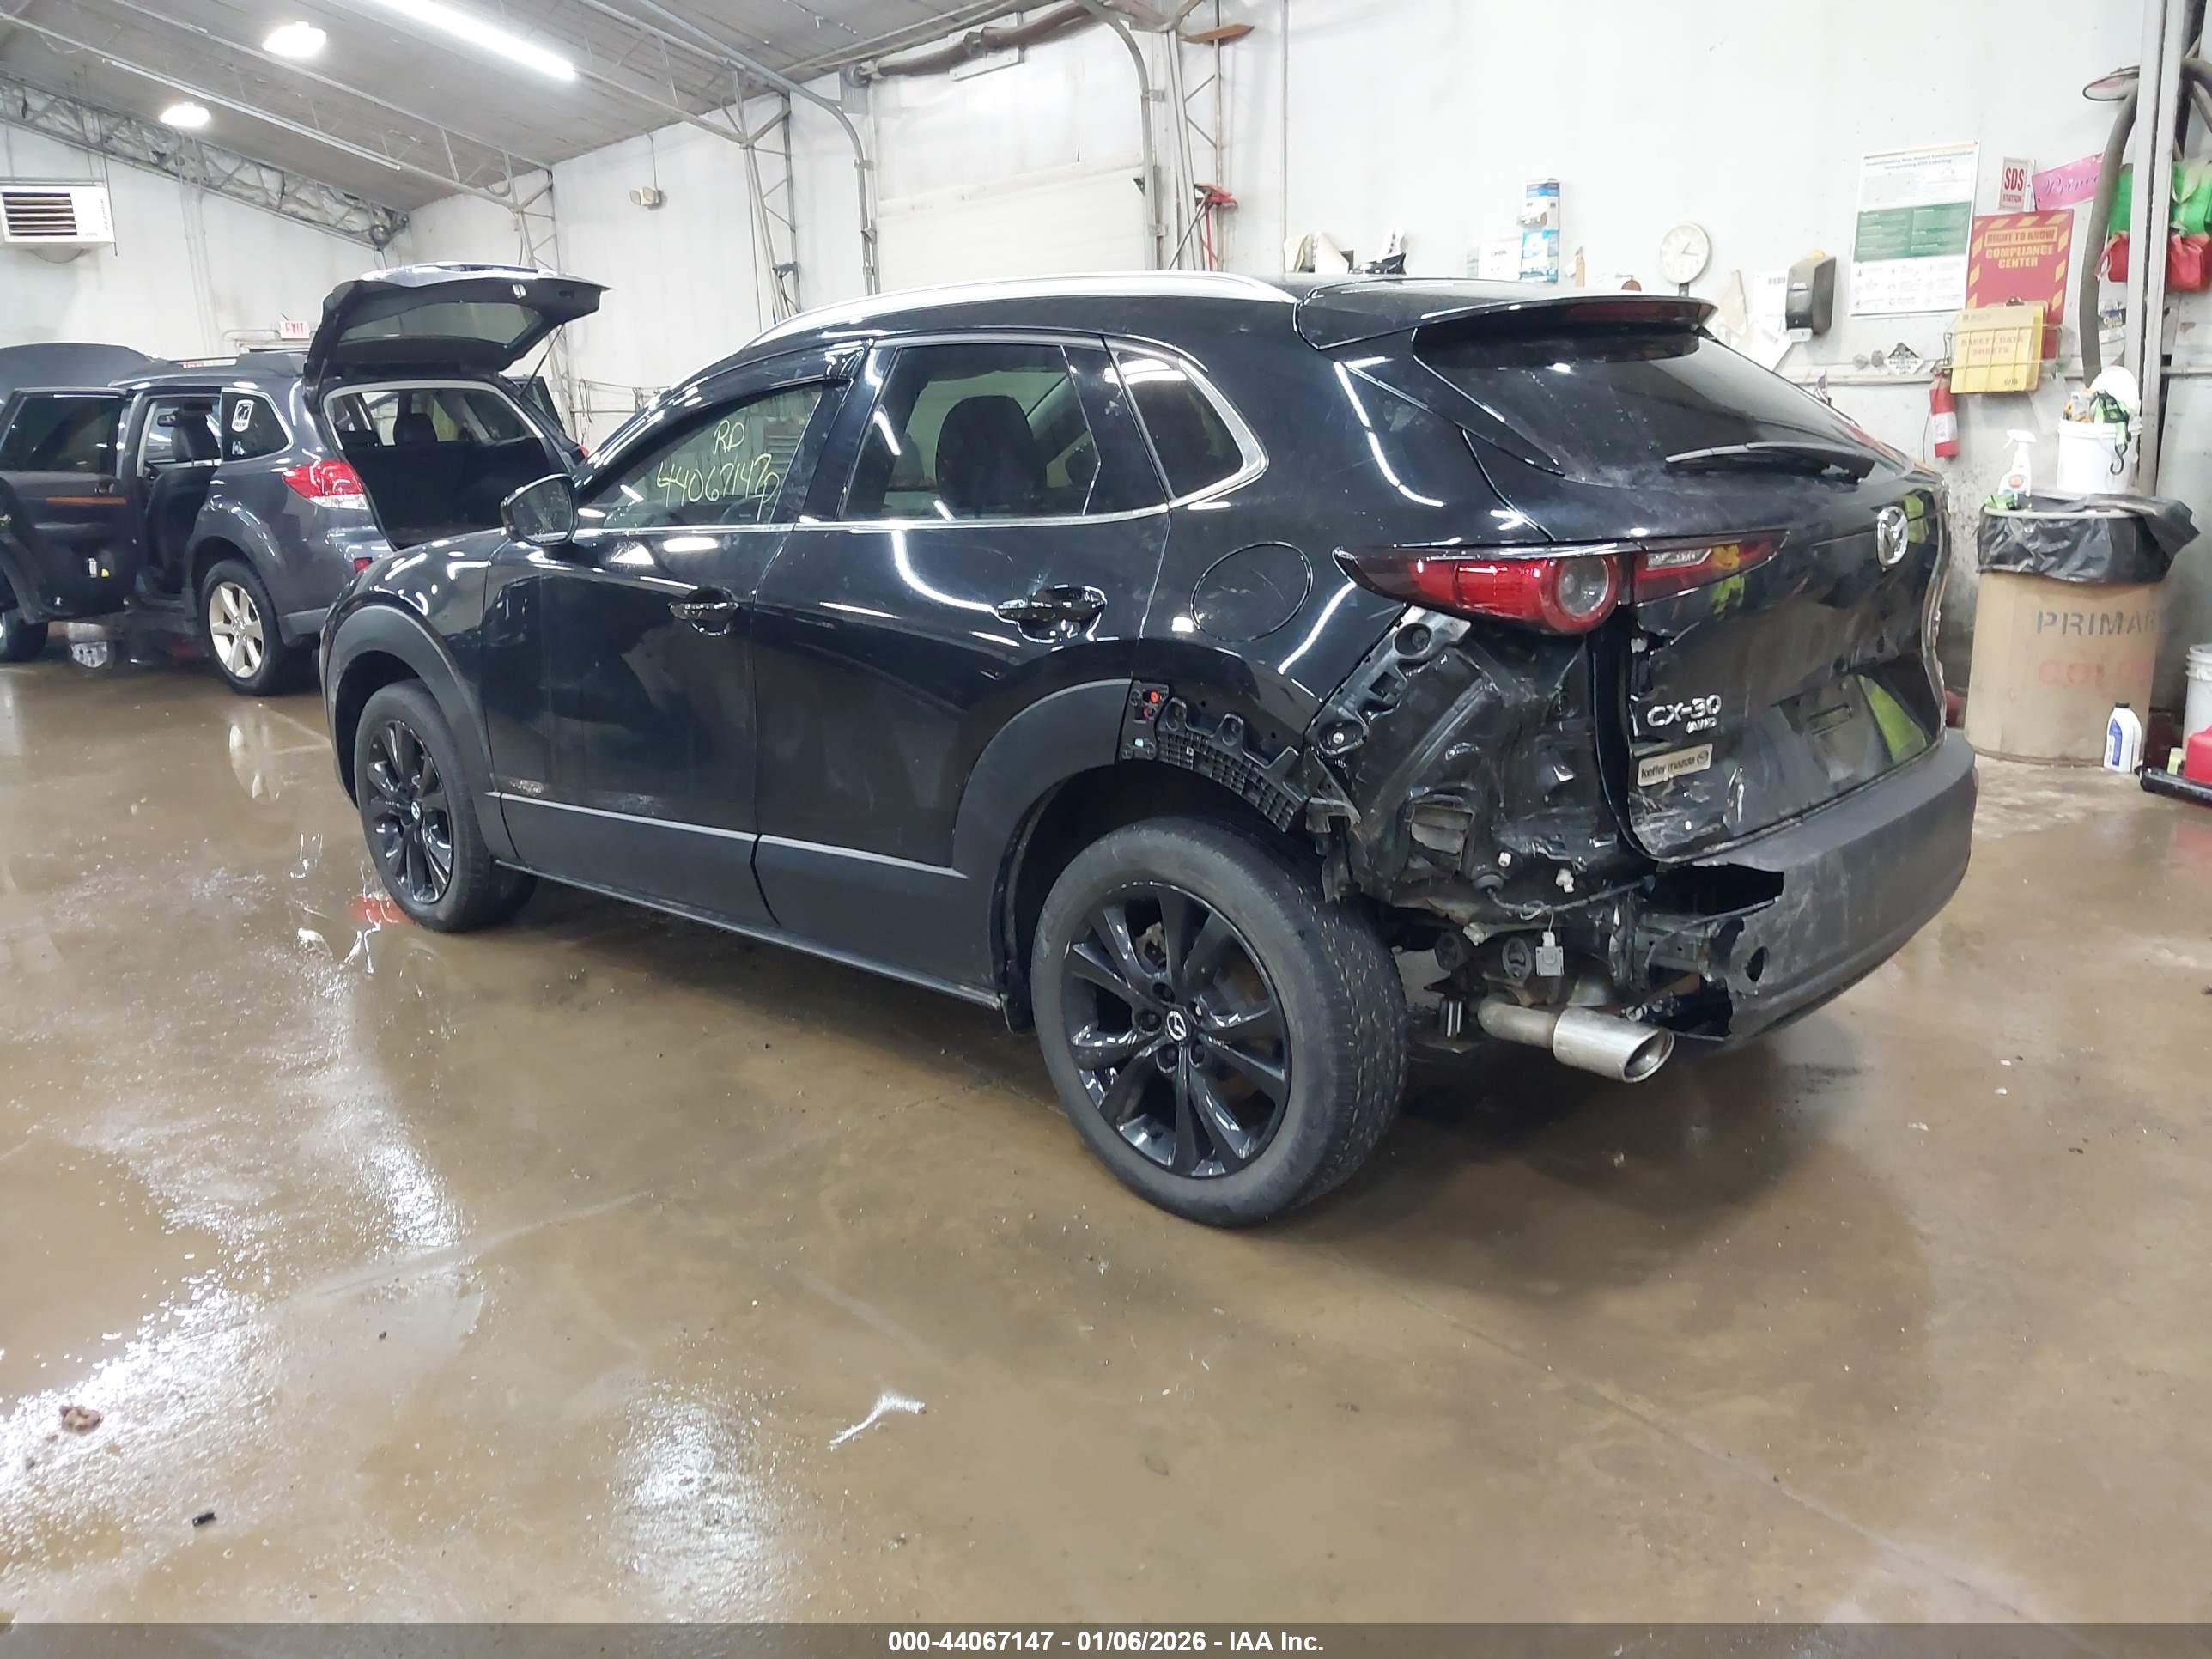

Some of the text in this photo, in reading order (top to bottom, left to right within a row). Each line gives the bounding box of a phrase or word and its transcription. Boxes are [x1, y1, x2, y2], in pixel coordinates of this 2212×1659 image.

[2004, 167, 2025, 191] SDS
[2002, 193, 2022, 203] STATION
[1986, 229, 2055, 243] RIGHT TO KNOW
[1985, 244, 2053, 258] COMPLIANCE
[1998, 257, 2039, 269] CENTER
[1999, 335, 2024, 344] DATA
[1647, 694, 1722, 727] CX-30
[1686, 717, 1717, 734] AWD
